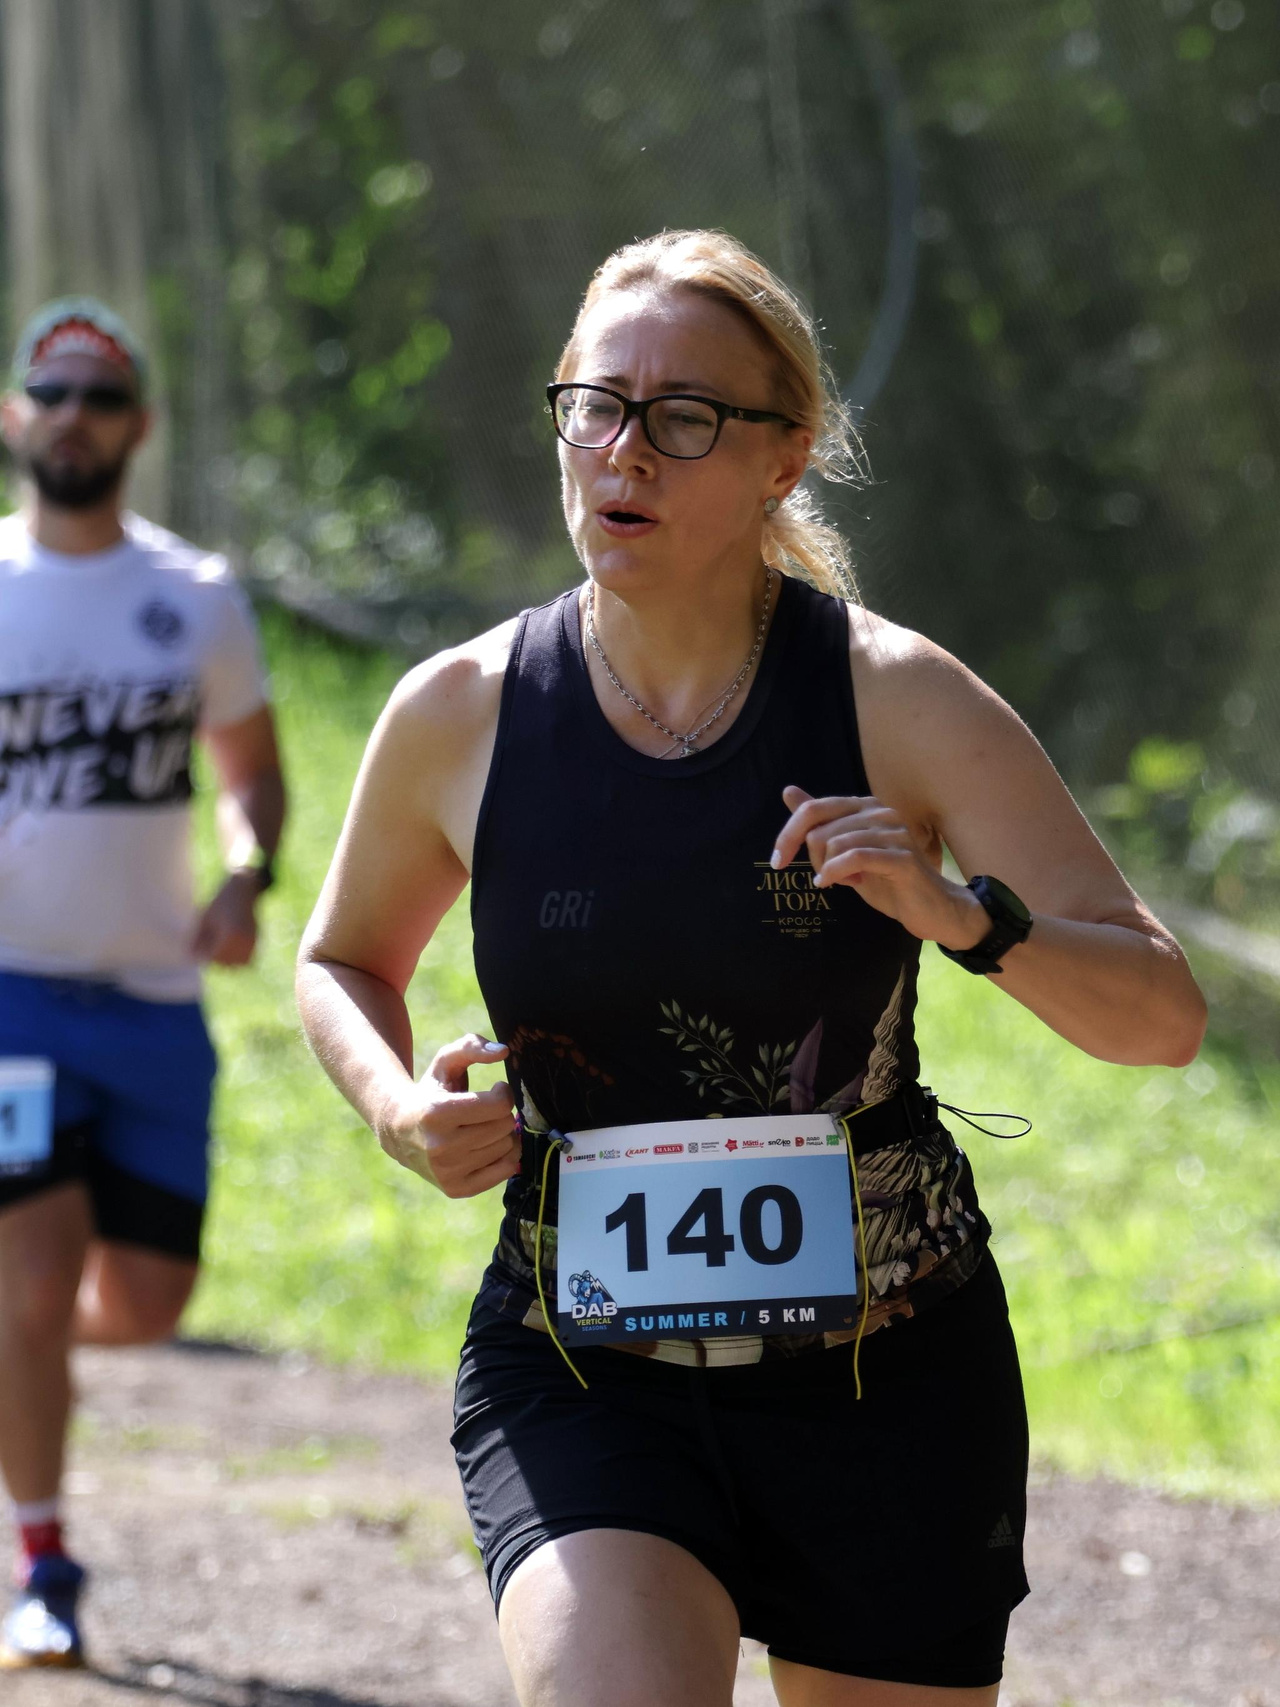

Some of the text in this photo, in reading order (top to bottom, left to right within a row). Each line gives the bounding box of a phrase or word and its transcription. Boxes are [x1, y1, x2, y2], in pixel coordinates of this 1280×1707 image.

[773, 892, 831, 911] ГОРА
[778, 917, 822, 926] КРОСС
[605, 1184, 804, 1273] 140
[571, 1301, 618, 1319] DAB
[576, 1317, 612, 1327] VERTICAL
[625, 1311, 729, 1332] SUMMER
[758, 1309, 770, 1324] 5
[783, 1307, 816, 1323] KM
